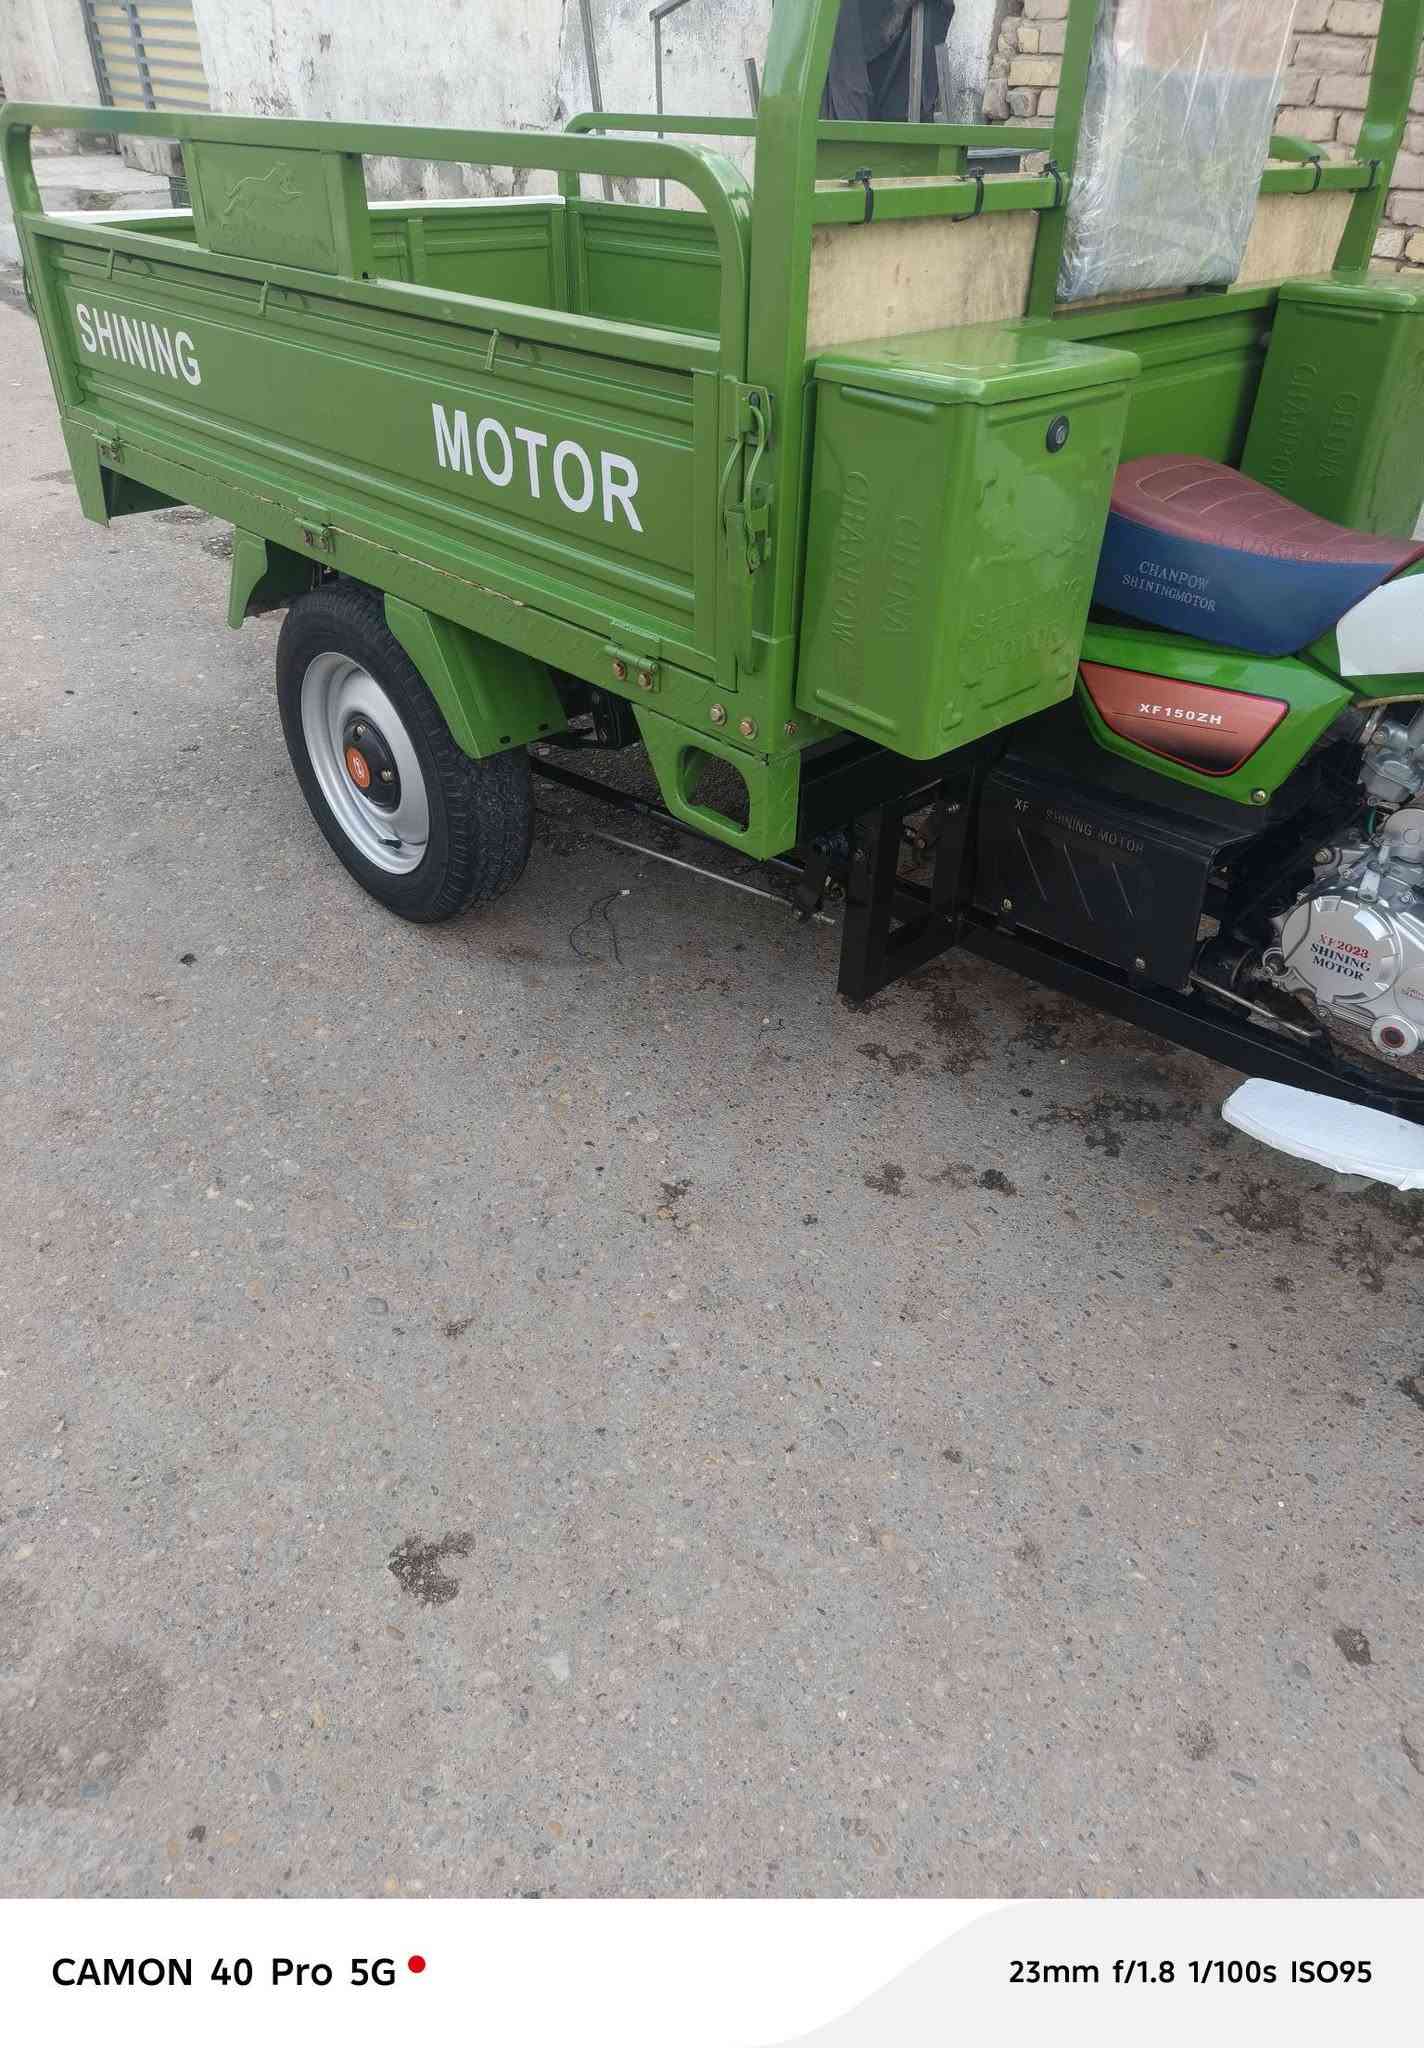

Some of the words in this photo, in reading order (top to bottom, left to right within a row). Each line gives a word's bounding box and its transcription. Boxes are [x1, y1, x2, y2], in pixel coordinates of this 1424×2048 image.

[75, 303, 202, 386] SHINING
[431, 402, 644, 533] MOTOR
[1138, 560, 1209, 592] CHANPOW
[1122, 574, 1217, 611] SHININGMOTOR
[1138, 702, 1223, 725] XF150ZH
[1014, 798, 1030, 813] XF
[1046, 808, 1093, 837] SHINING
[1099, 829, 1145, 854] MOTOR
[1310, 942, 1371, 972] SHINING
[1319, 933, 1370, 959] XF2023
[1312, 955, 1364, 981] MOTOR
